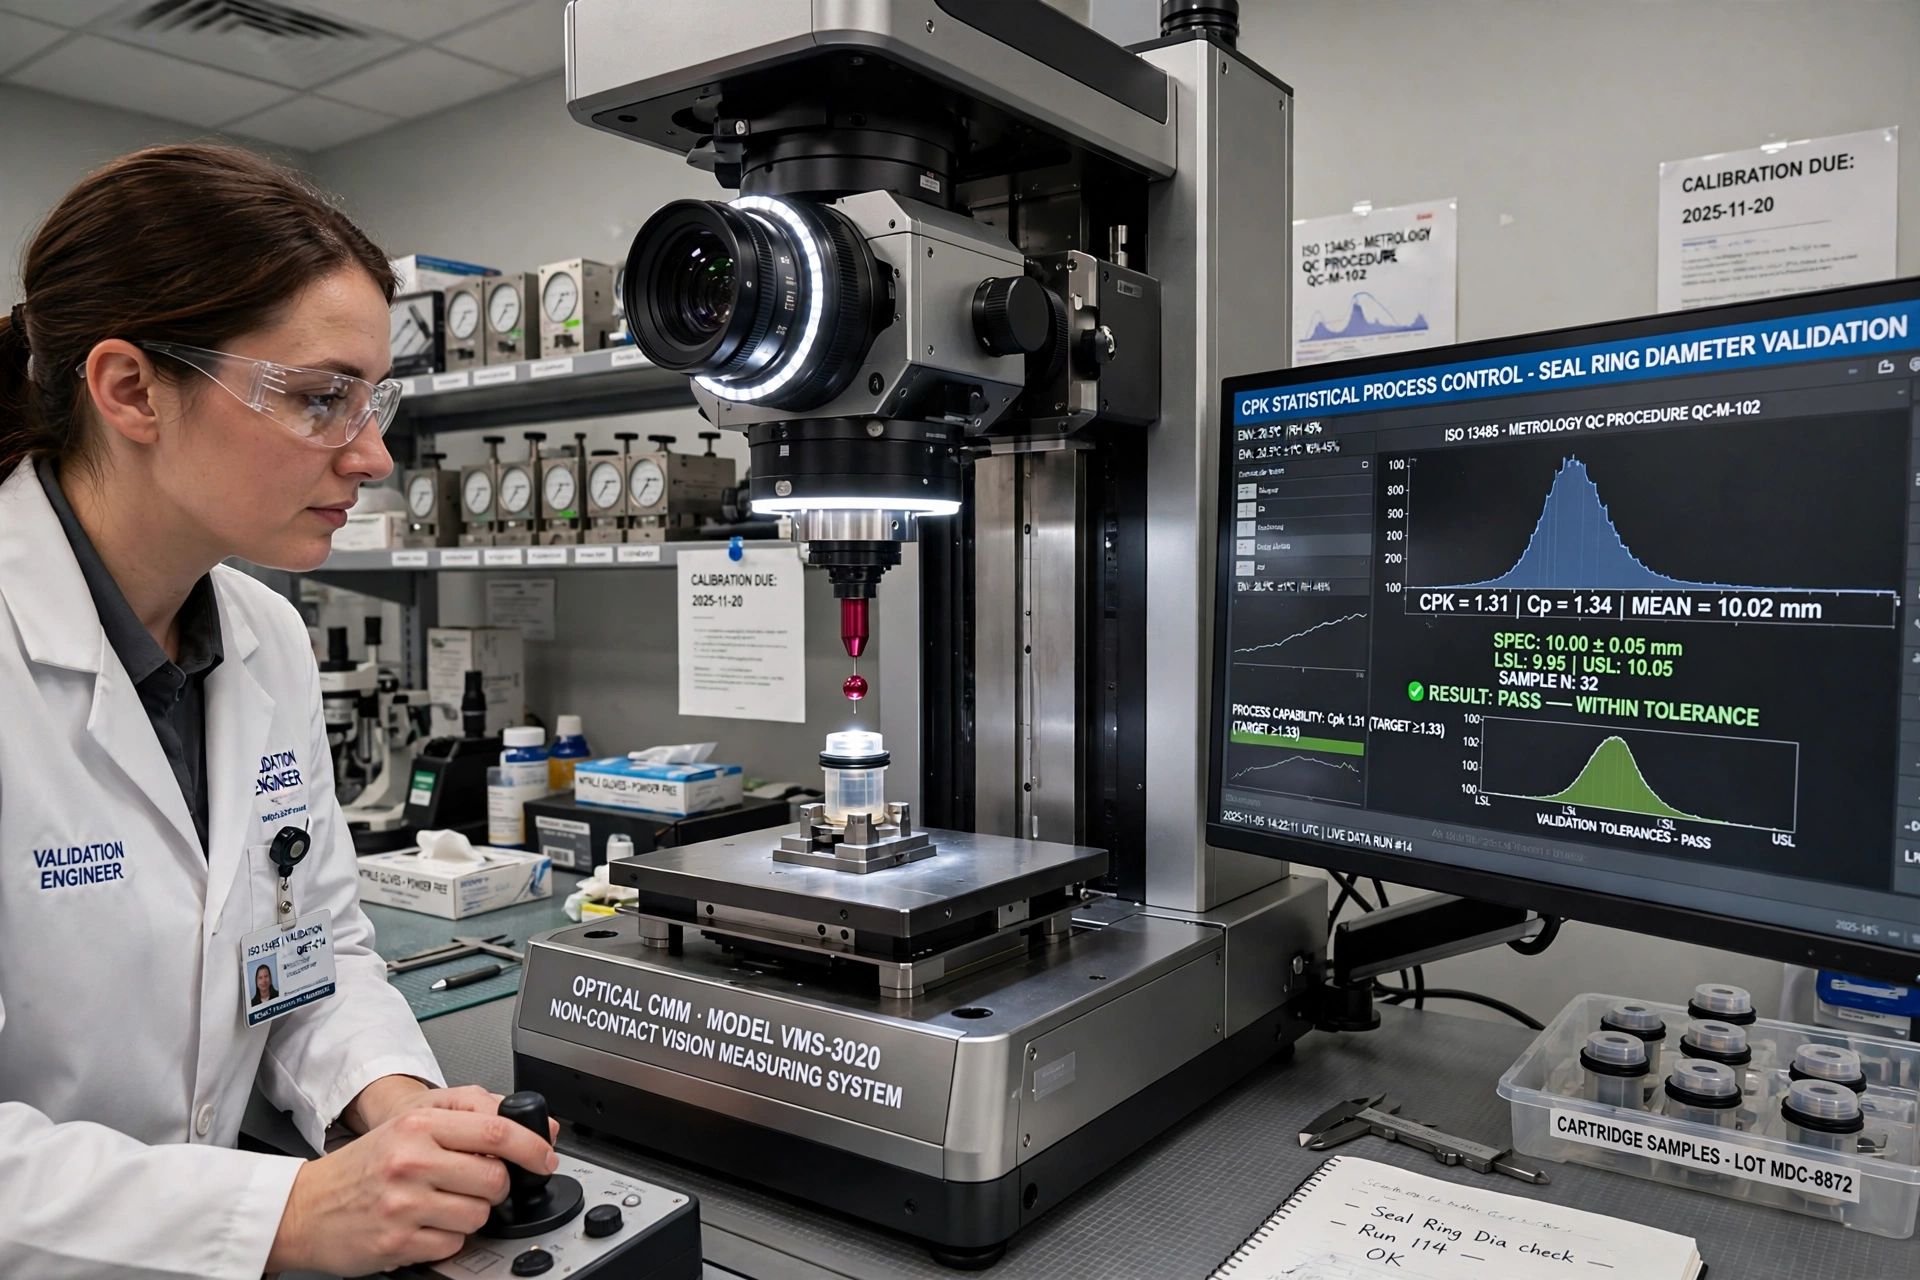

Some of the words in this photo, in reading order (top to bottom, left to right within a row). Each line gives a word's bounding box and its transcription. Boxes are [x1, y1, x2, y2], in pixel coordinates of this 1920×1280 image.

[1682, 161, 1802, 193] CALIBRATION
[1809, 154, 1854, 174] DUE:
[1682, 196, 1774, 224] 2025-11-20
[1302, 244, 1320, 257] ISO
[1364, 226, 1431, 248] METROLOGY
[1302, 260, 1320, 273] QC
[1307, 269, 1367, 287] QC-M-102
[1241, 398, 1269, 416] CPK
[1272, 387, 1360, 413] STATISTICAL
[1363, 377, 1437, 401] PROCESS
[1441, 366, 1523, 392] CONTROL
[1539, 358, 1587, 381] SEAL
[1591, 350, 1640, 375] RING
[1645, 334, 1756, 368] DIAMETER
[1761, 314, 1908, 353] VALIDATION
[1444, 428, 1464, 441] ISO
[1467, 425, 1499, 440] 13485
[1508, 416, 1583, 436] METROLOGY
[1585, 415, 1604, 429] QC
[1606, 407, 1688, 426] PROCEDURE
[1691, 400, 1760, 421] QC-M-102
[1388, 459, 1405, 470] 100
[691, 573, 752, 586] CALIBRATION
[755, 573, 777, 586] DUE:
[1385, 582, 1402, 593] 100
[692, 594, 743, 607] 2025-11-20
[1419, 594, 1455, 611] CPK
[1475, 594, 1508, 612] 1.31
[1527, 595, 1552, 617] Cp
[1557, 600, 1568, 608] =
[1574, 596, 1613, 614] 1.34
[1632, 596, 1691, 615] MEAN
[1698, 603, 1711, 611] =
[1718, 597, 1773, 617] 10.02
[1780, 603, 1822, 619] mm
[1493, 632, 1541, 650] SPEC:
[1546, 635, 1588, 651] 10.00
[1593, 638, 1604, 653] ±
[1609, 637, 1646, 654] 0.05
[1650, 641, 1683, 656] mm
[1494, 652, 1528, 669] LSL:
[1532, 653, 1566, 671] 9.95
[1583, 656, 1621, 674] USL:
[1627, 658, 1673, 677] 10.05
[1499, 671, 1557, 688] SAMPLE
[1560, 674, 1576, 690] N:
[1580, 676, 1599, 691] 32
[1232, 704, 1271, 719] PROCESS
[1272, 707, 1325, 724] CAPABILITY:
[1327, 712, 1345, 728] Cpk
[1347, 715, 1365, 727] 1.31
[1369, 716, 1411, 733] (TARGET
[1429, 685, 1493, 706] RESULT:
[1498, 690, 1541, 709] PASS
[1576, 695, 1639, 718] WITHIN
[1644, 701, 1759, 727] TOLERANCE
[1463, 713, 1480, 724] 100
[1233, 721, 1269, 735] (TARGET
[1462, 760, 1478, 771] 100
[1461, 784, 1477, 794] 100
[1475, 795, 1491, 806] LSL
[1223, 810, 1265, 826] 2025-11-05
[1301, 824, 1319, 836] UTC
[1326, 828, 1345, 841] LIVE
[1347, 831, 1371, 846] DATA
[1373, 835, 1393, 849] RUN
[1536, 812, 1597, 832] VALIDATION
[1600, 821, 1671, 843] TOLERANCES
[1681, 833, 1711, 849] PASS
[1772, 833, 1795, 847] USL
[34, 841, 124, 868] VALIDATION
[40, 862, 124, 889] ENGINEER
[572, 975, 642, 1012] OPTICAL
[648, 993, 692, 1024] CMM
[707, 1009, 774, 1045] MODEL
[781, 1025, 881, 1071] VMS-3020
[550, 998, 659, 1044] NON-CONTACT
[662, 1026, 715, 1059] VISION
[719, 1044, 823, 1088] MEASURING
[826, 1070, 903, 1109] SYSTEM
[1557, 1115, 1643, 1149] CARTRIDGE
[1647, 1135, 1720, 1165] SAMPLES
[1734, 1152, 1766, 1175] LOT
[1771, 1160, 1853, 1194] MDC-8872
[1358, 1223, 1396, 1243] Run
[1411, 1238, 1448, 1255] 114
[1371, 1206, 1414, 1224] Seal
[1423, 1218, 1462, 1241] Ring
[1474, 1230, 1507, 1248] Dia
[1519, 1243, 1574, 1264] check
[1366, 1248, 1405, 1267] OK
